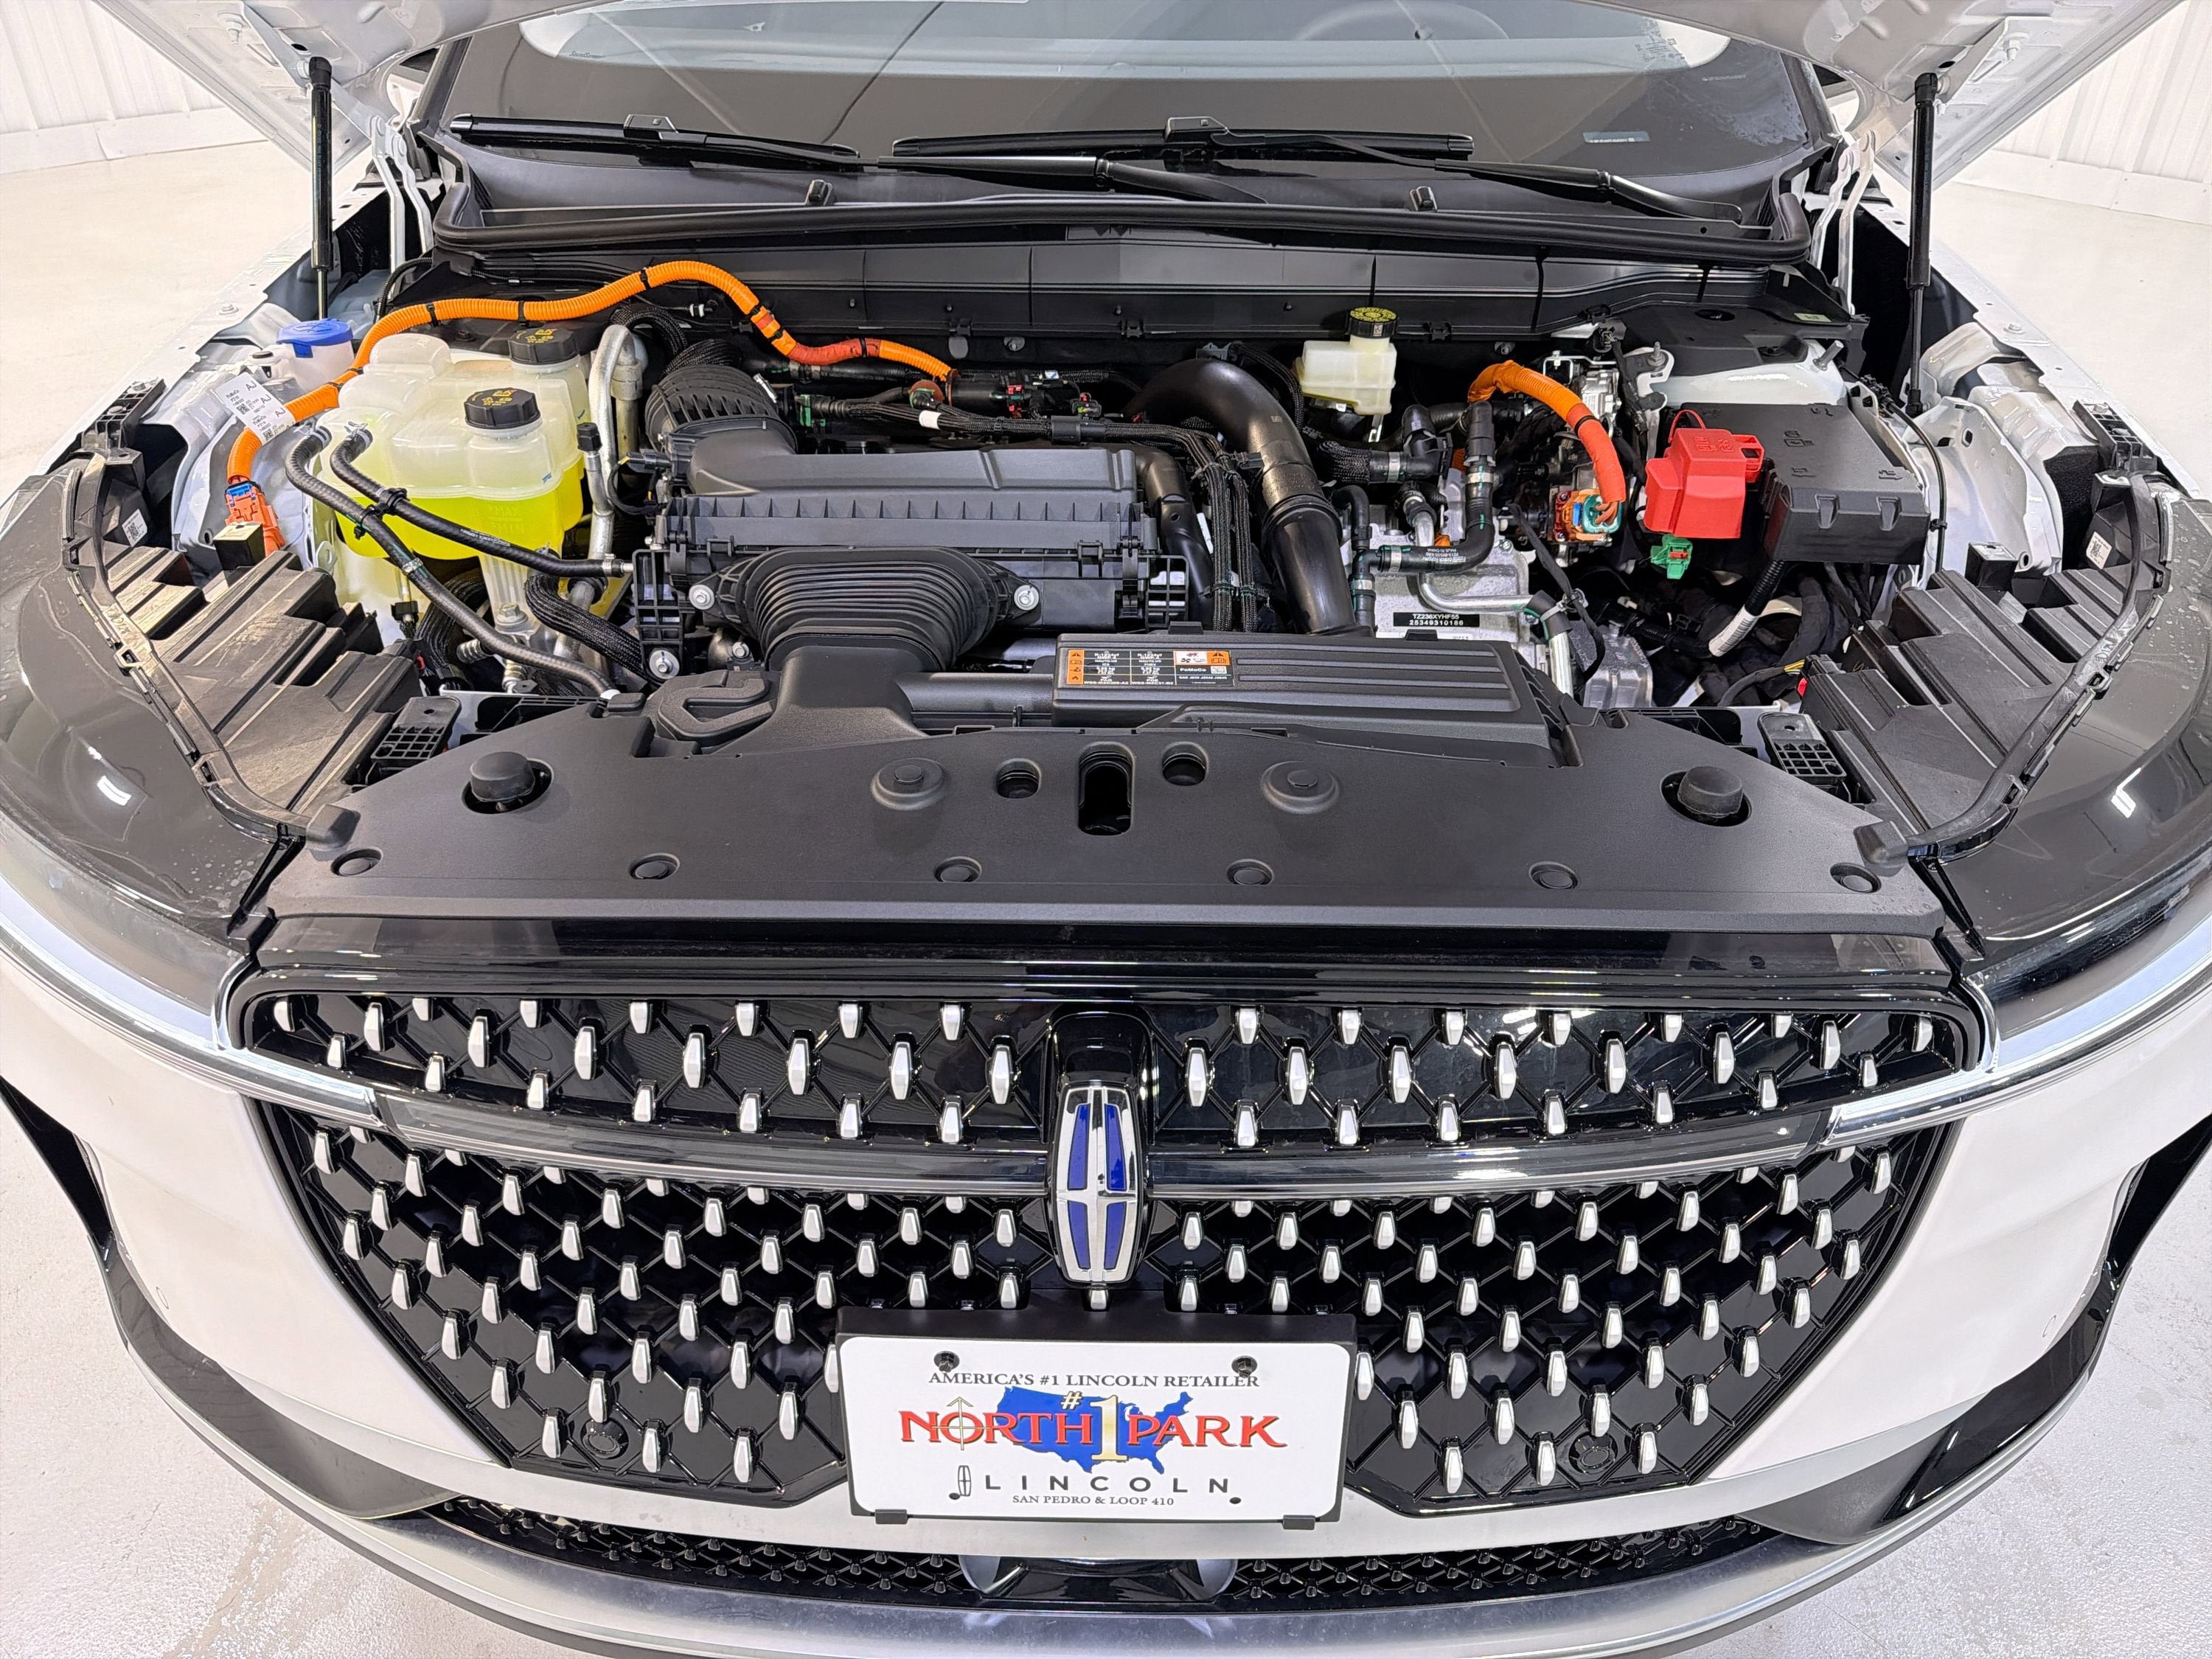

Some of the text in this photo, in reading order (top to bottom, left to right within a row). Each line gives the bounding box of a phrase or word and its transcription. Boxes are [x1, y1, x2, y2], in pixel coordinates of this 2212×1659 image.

[246, 380, 257, 391] AJ
[260, 394, 272, 404] AJ
[275, 407, 286, 417] AJ
[928, 1372, 1260, 1388] AMERICA'S #1 LINCOLN RETAILER
[898, 1411, 1288, 1448] NORTH PARK
[984, 1475, 1229, 1494] LINCOLN
[1012, 1495, 1175, 1506] SAN PEDRO & LOOP 410
